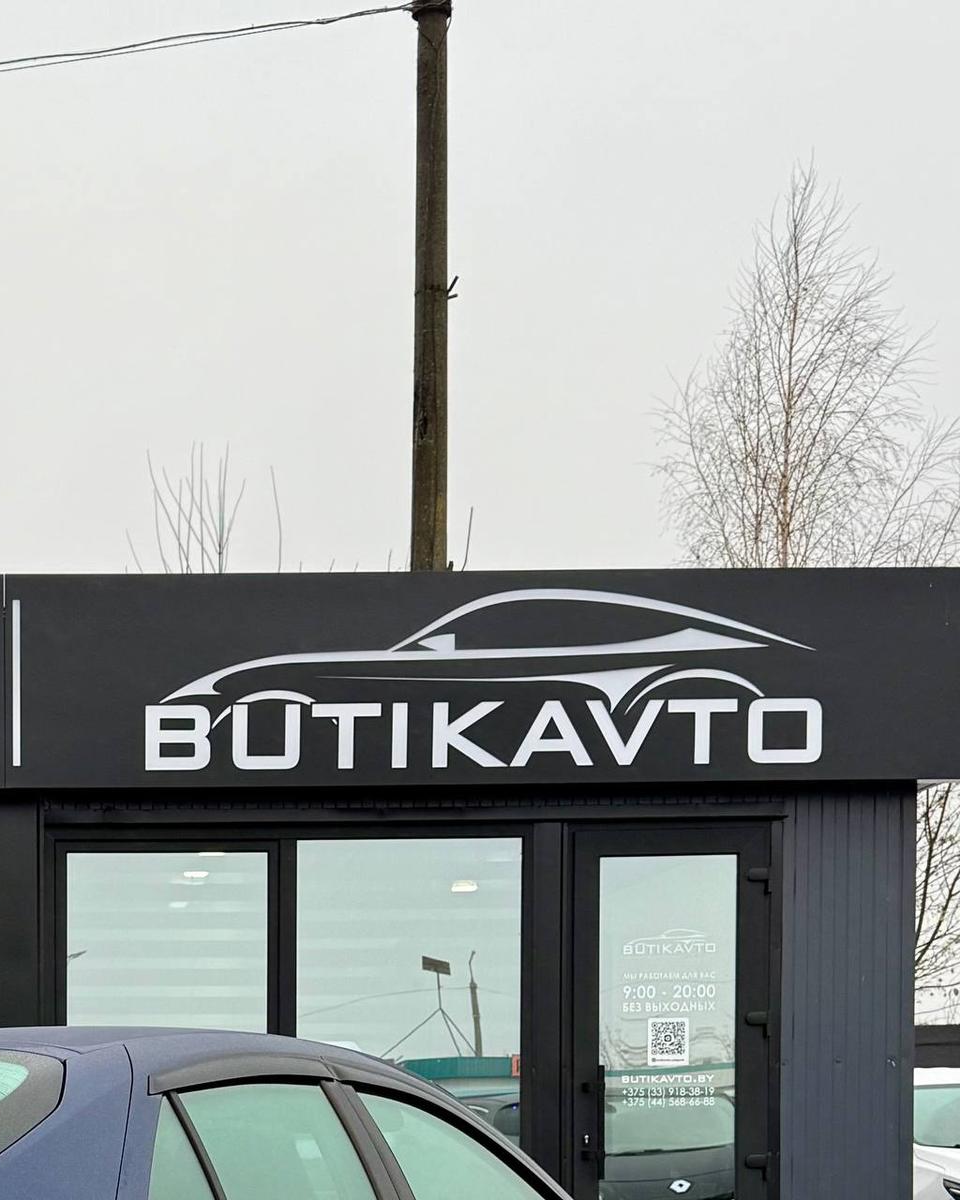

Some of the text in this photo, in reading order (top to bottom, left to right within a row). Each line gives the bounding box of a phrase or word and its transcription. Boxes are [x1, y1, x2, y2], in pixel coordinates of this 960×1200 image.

[144, 696, 823, 771] BUTIKAVTO
[623, 943, 716, 955] BUTIKAVTO
[623, 985, 656, 999] 9:00
[673, 984, 716, 998] 20:00
[622, 1001, 716, 1012] БЕЗ ВЫХОДНЫХ
[621, 1074, 714, 1084] BUTIKAVTO.BY
[622, 1086, 715, 1098] +375 (33) 918-38-19
[622, 1097, 716, 1108] +375 (44) 568-66-88
